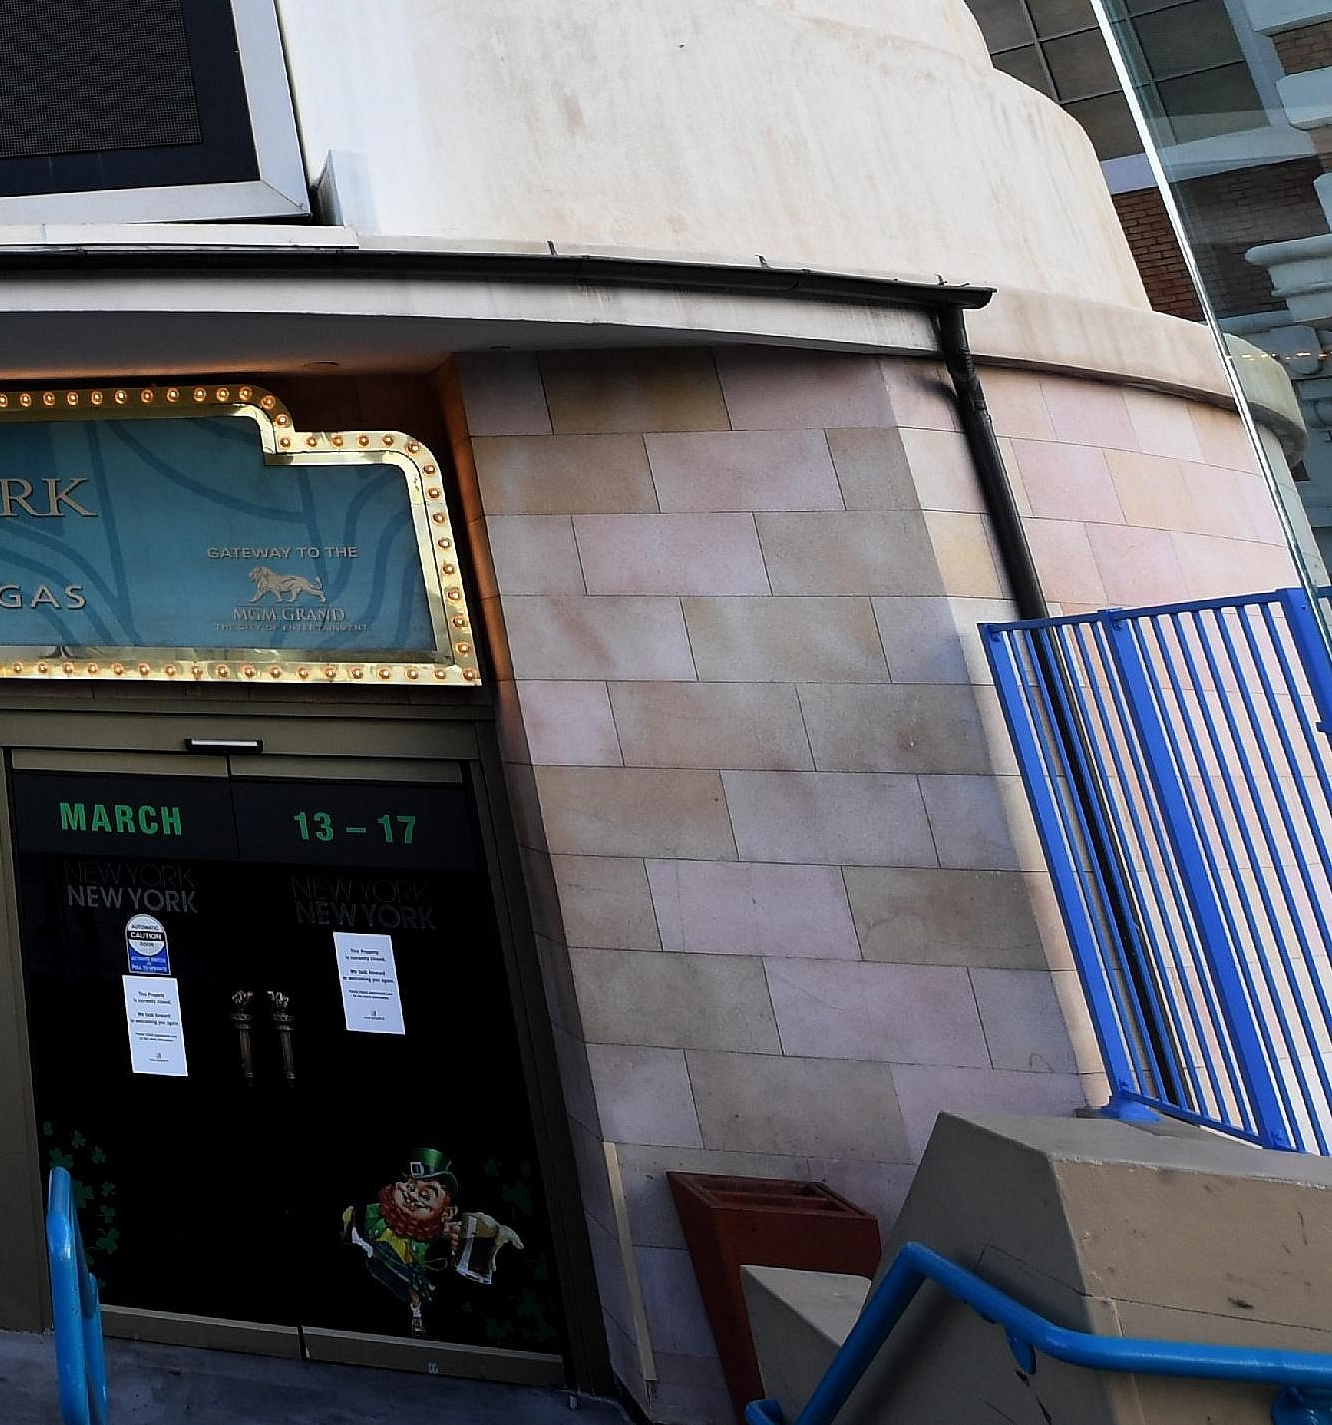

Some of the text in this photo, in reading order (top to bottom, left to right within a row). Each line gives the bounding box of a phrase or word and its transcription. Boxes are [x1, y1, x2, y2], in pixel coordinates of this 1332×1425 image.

[206, 546, 360, 560] GATEWAY TO THE
[233, 606, 348, 623] MGM GRAND
[59, 802, 183, 836] MARCH
[292, 811, 335, 843] 13
[376, 814, 417, 846] 17
[66, 885, 198, 914] NEW YORK
[130, 931, 162, 941] CAUTION
